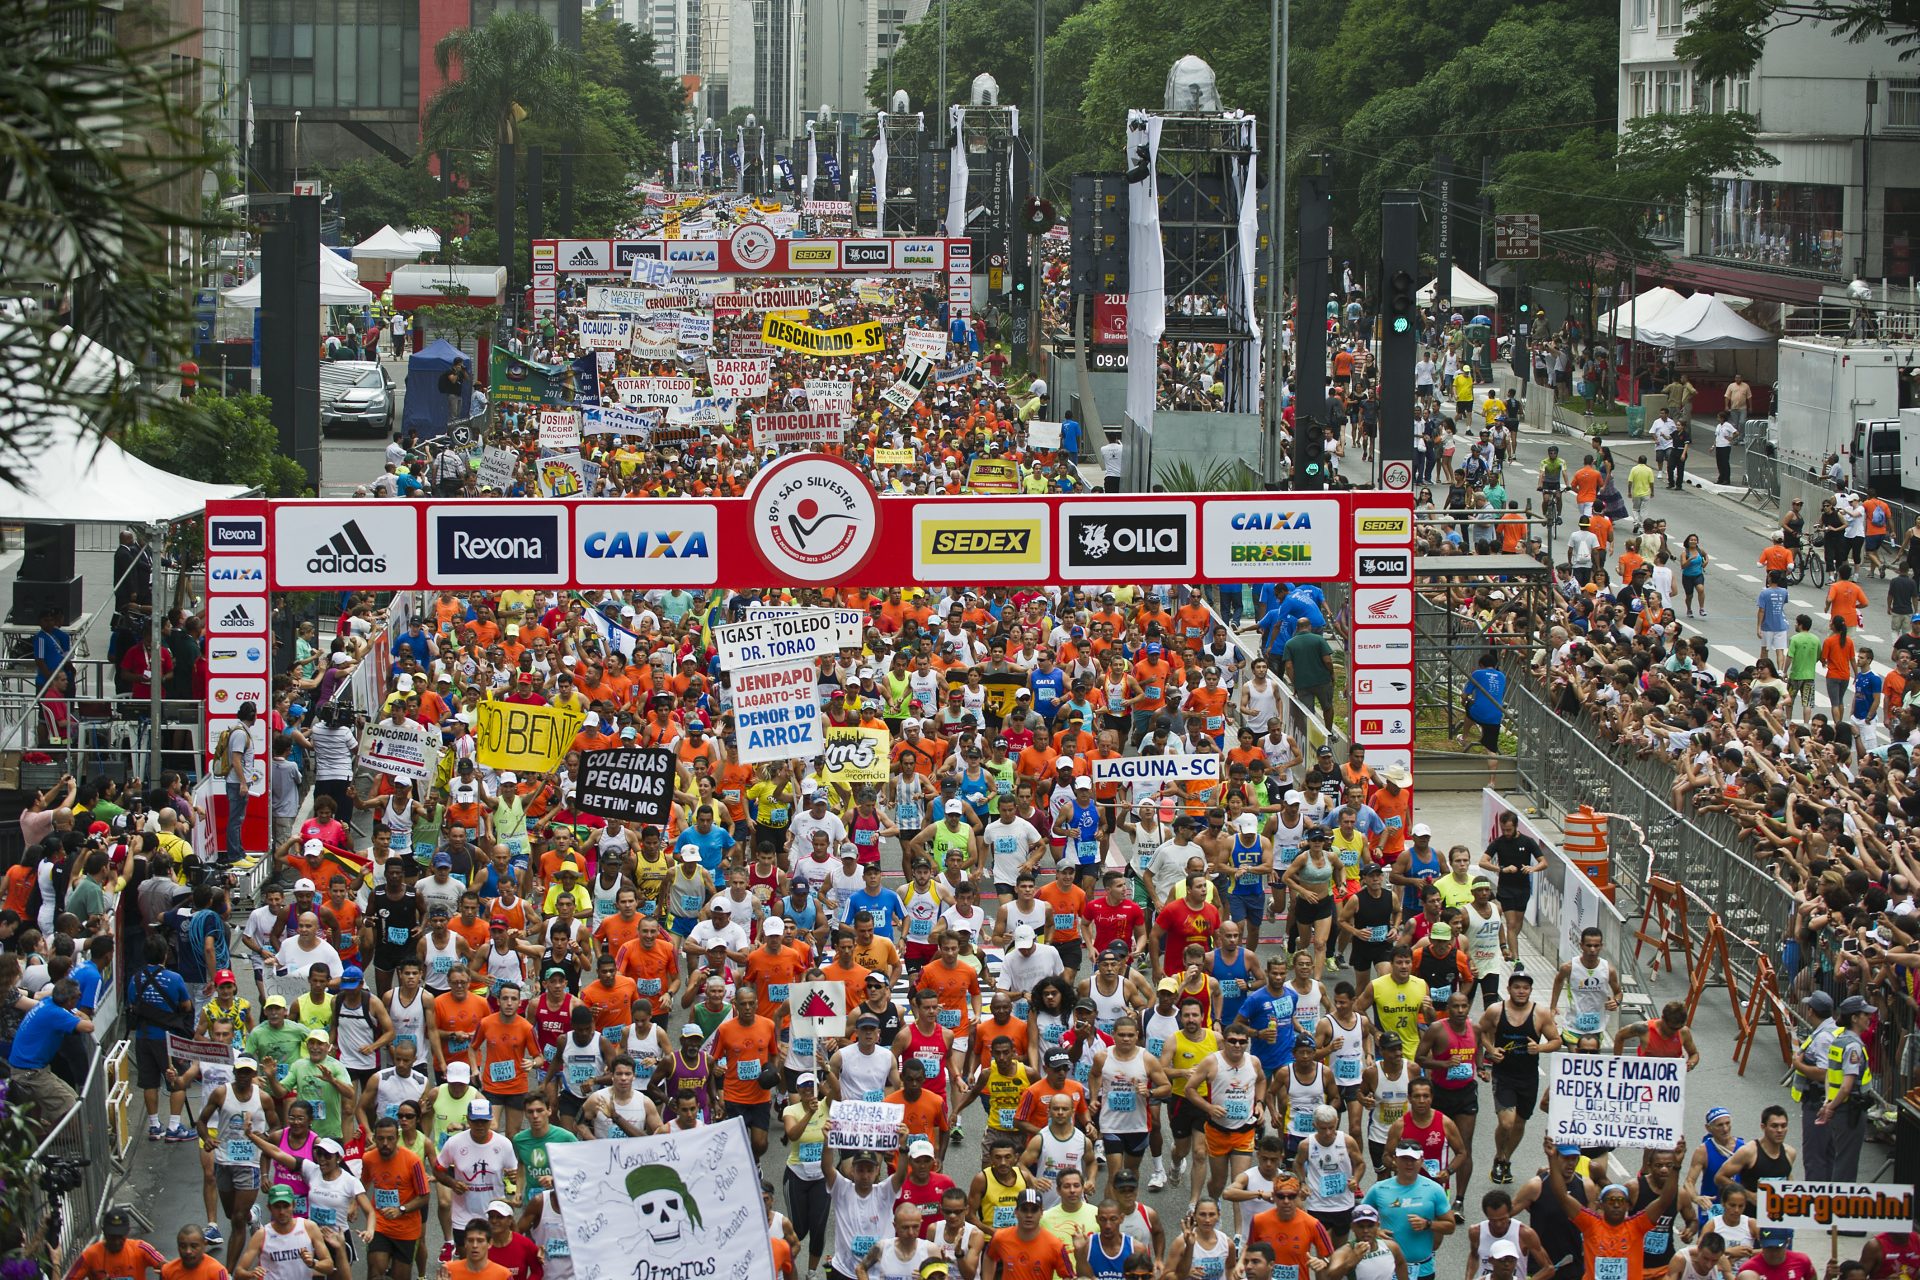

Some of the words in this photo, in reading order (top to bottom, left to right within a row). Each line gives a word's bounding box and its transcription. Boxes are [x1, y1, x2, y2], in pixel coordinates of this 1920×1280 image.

[993, 162, 1001, 192] Branca
[1440, 181, 1448, 212] Gomide
[803, 202, 842, 210] VINHEDO
[992, 196, 1000, 219] Casa
[670, 251, 716, 261] CAIXA
[796, 251, 831, 260] SEDEX
[904, 244, 934, 252] CAIXA
[569, 257, 598, 266] adidas
[904, 256, 934, 264] BRASIL
[633, 257, 674, 285] PIÊN
[611, 290, 644, 298] MASTER
[754, 290, 812, 308] CERQUILHO
[646, 296, 688, 310] CERQUILHO
[583, 322, 613, 337] OCAUÇU
[618, 324, 628, 336] SP
[768, 319, 854, 350] DESCALVADO
[864, 327, 882, 346] SP
[717, 360, 756, 372] BARRA
[1096, 354, 1128, 367] 09:0
[618, 380, 650, 390] ROTARY
[656, 380, 690, 390] TOLEDO
[714, 373, 734, 386] SÃO
[740, 372, 767, 386] JOÃO
[544, 390, 562, 398] 2014
[630, 394, 646, 404] DR.
[648, 394, 678, 404] TORAO
[542, 414, 576, 425] JOSIMAR
[756, 412, 841, 432] CHOCOLATE
[776, 431, 820, 442] DIVINÓPOLIS
[826, 431, 838, 440] MG
[484, 457, 511, 471] NUNCA
[778, 480, 802, 500] SÃO
[807, 476, 856, 510] SILVESTRE
[1231, 512, 1312, 530] CAIXA
[1364, 521, 1402, 531] SEDEX
[218, 527, 256, 540] Rexona
[454, 530, 542, 561] Rexona
[584, 530, 709, 560] CAIXA
[936, 532, 1027, 552] SEDEX
[1231, 544, 1312, 562] BRASIL
[307, 554, 386, 574] adidas
[212, 568, 263, 580] CAIXA
[220, 617, 255, 628] adidas
[722, 625, 763, 644] IGAST
[774, 615, 832, 638] TOLEDO
[741, 646, 766, 662] DR.
[768, 636, 816, 658] TORAO
[736, 666, 813, 693] JENIPAPO
[235, 691, 260, 700] CBN
[737, 687, 811, 709] LAGARTO-SE
[738, 707, 790, 728] DENOR
[795, 704, 816, 720] DO
[366, 726, 418, 744] CONCÓRDIA
[425, 736, 437, 748] SC
[748, 722, 813, 750] ARROZ
[361, 756, 412, 774] VASSOURAS
[1097, 759, 1178, 778] LAGUNA
[585, 770, 666, 796] PEGADAS
[634, 800, 658, 816] MG
[1238, 852, 1261, 862] CET
[1562, 1058, 1604, 1078] DEUS
[1608, 1057, 1620, 1078] É
[1622, 1062, 1678, 1082] MAIOR
[1556, 1080, 1602, 1098] REDEX
[1607, 1082, 1653, 1102] Libra
[1658, 1084, 1680, 1103] RIO
[1575, 1098, 1651, 1114] LOGISTICA
[1572, 1110, 1622, 1123] ESTAMOS
[1624, 1116, 1644, 1126] AQUI
[1646, 1116, 1659, 1126] NA
[828, 1132, 860, 1147] EVALDO
[862, 1134, 874, 1148] DE
[876, 1134, 898, 1148] MELO
[1592, 1123, 1673, 1141] SILVESTRE
[1782, 1183, 1872, 1194] FAMÍLIA
[1758, 1183, 1913, 1224] bergamini
[1600, 1264, 1623, 1274] 24271
